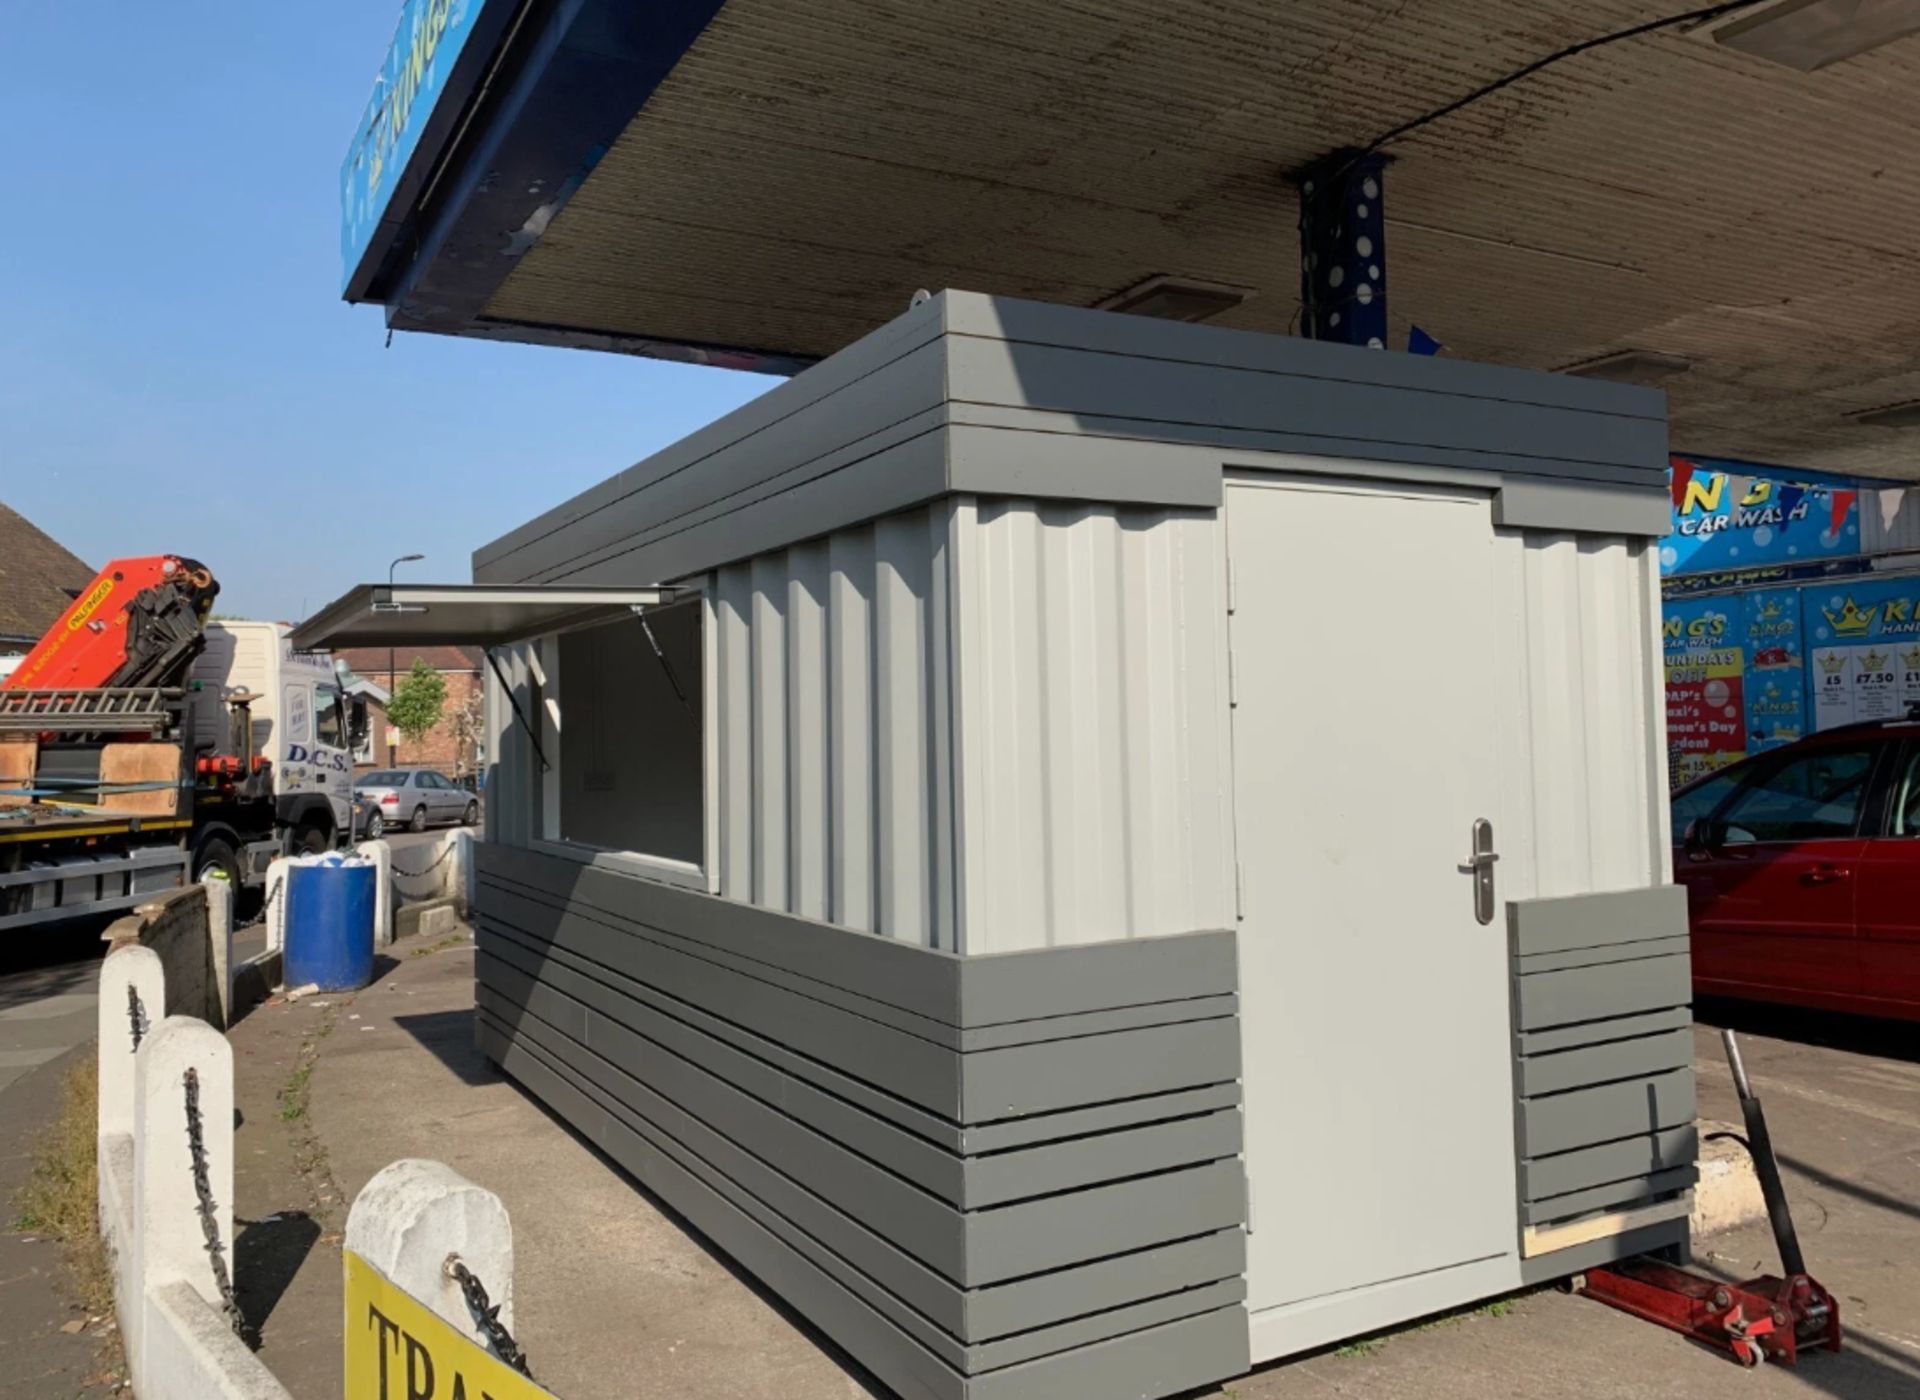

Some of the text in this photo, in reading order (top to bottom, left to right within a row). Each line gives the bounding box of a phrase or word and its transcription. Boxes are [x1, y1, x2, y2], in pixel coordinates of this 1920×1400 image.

[1681, 515, 1728, 535] CAR
[70, 581, 111, 627] PALFINGER
[1663, 618, 1724, 636] NGS
[1666, 652, 1734, 667] UNT DAYS
[1826, 675, 1841, 685] £5
[1856, 673, 1894, 684] £7.50
[1666, 705, 1699, 717] axi's
[1667, 721, 1737, 735] men's Day
[1673, 736, 1710, 748] dent
[287, 744, 348, 773] D.C.S.
